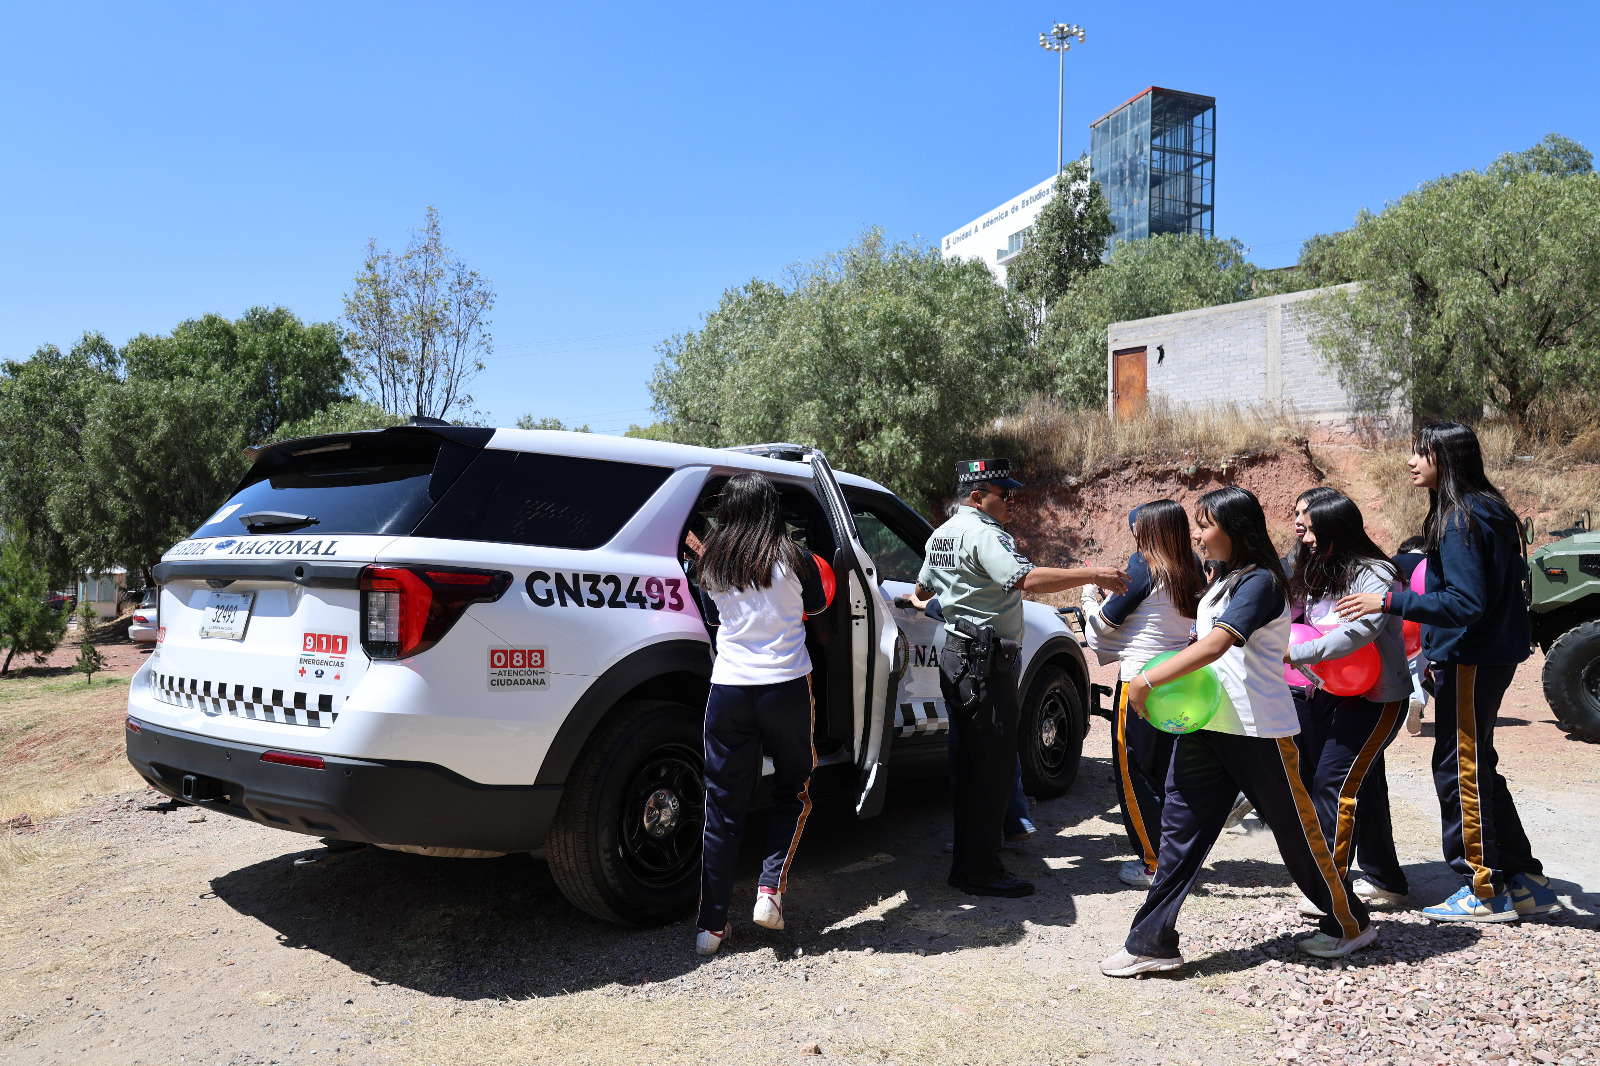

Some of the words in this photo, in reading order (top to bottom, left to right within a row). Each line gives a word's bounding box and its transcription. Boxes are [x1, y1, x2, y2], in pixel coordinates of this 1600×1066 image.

[1010, 204, 1018, 214] de
[1021, 188, 1050, 209] Estudios
[228, 540, 338, 556] NACIONAL
[928, 553, 956, 568] NACIONAL
[525, 570, 685, 612] GN32493
[212, 604, 238, 623] 32493
[305, 635, 343, 652] 911
[299, 658, 345, 668] EMERGENCIAS
[493, 652, 542, 666] 088
[497, 668, 539, 676] ATENCIÓN
[490, 678, 546, 686] CIUDADANA
